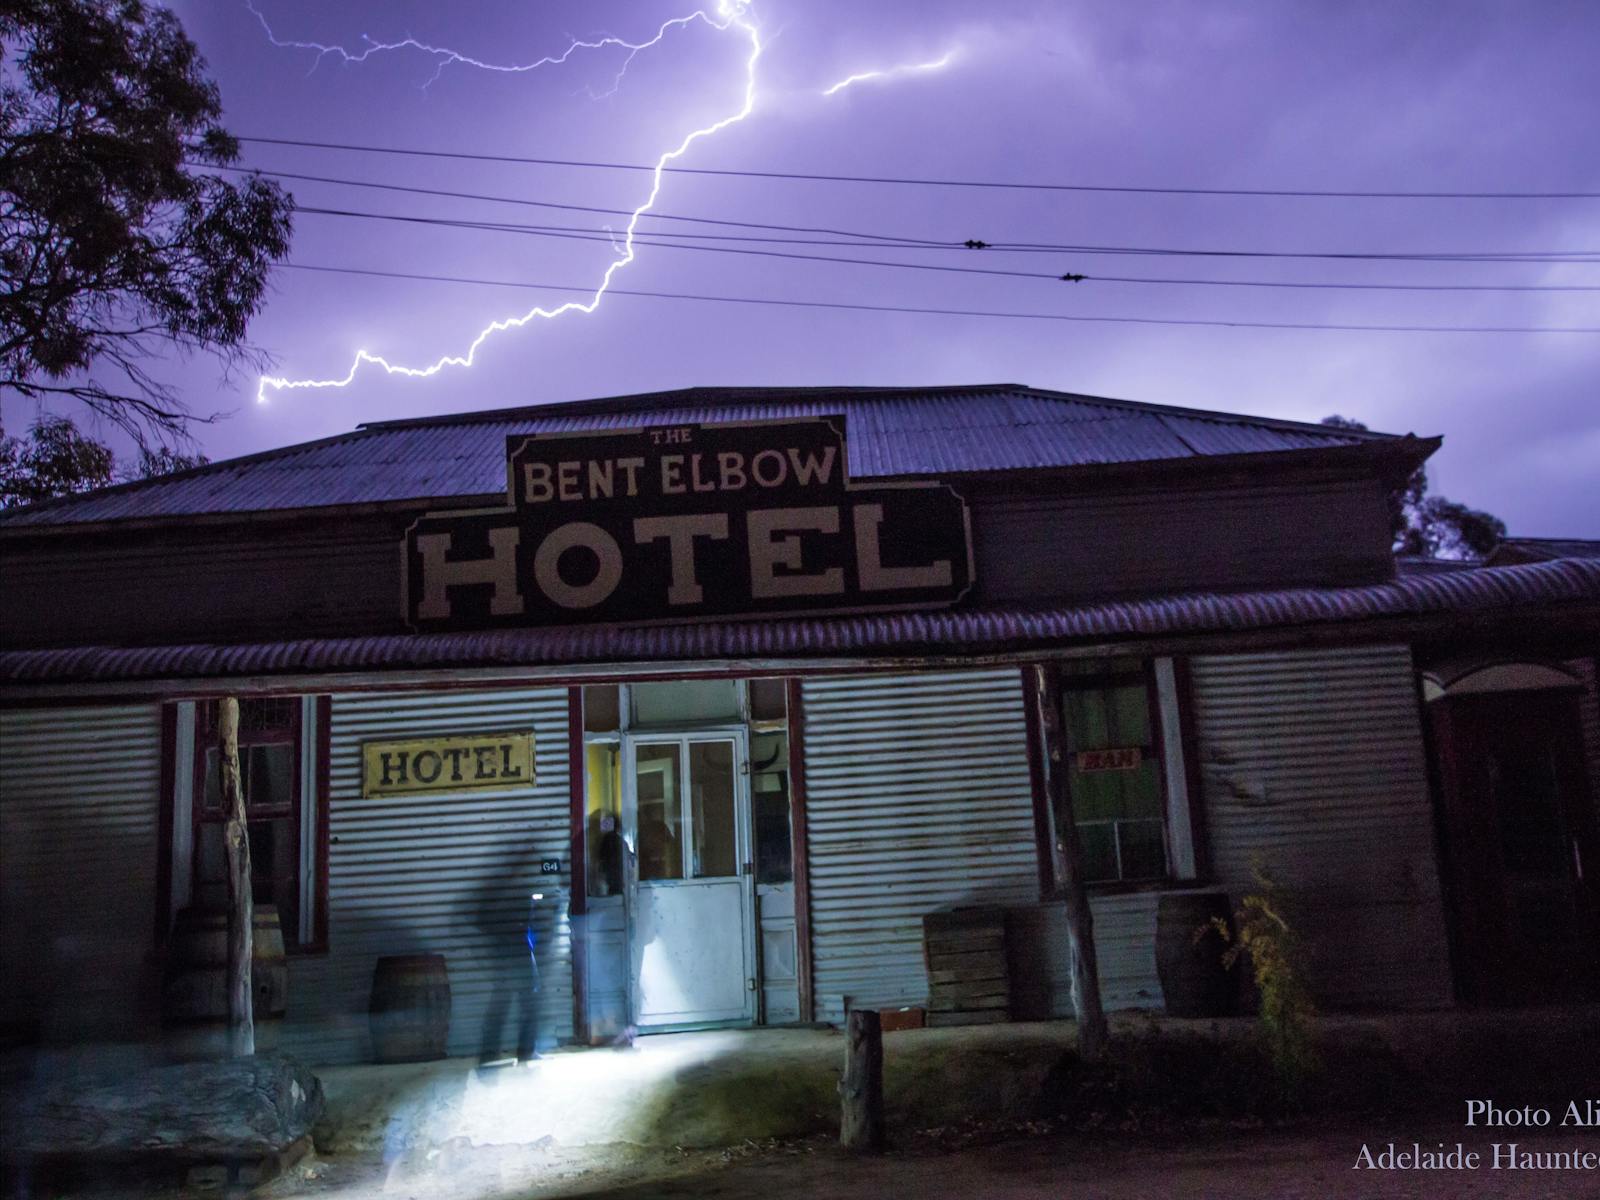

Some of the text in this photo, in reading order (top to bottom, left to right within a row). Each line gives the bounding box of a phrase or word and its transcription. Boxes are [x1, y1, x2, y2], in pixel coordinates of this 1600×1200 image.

[650, 428, 692, 445] THE
[523, 446, 837, 502] BENT ELBOW
[416, 504, 953, 620] HOTEL
[379, 745, 522, 786] HOTEL
